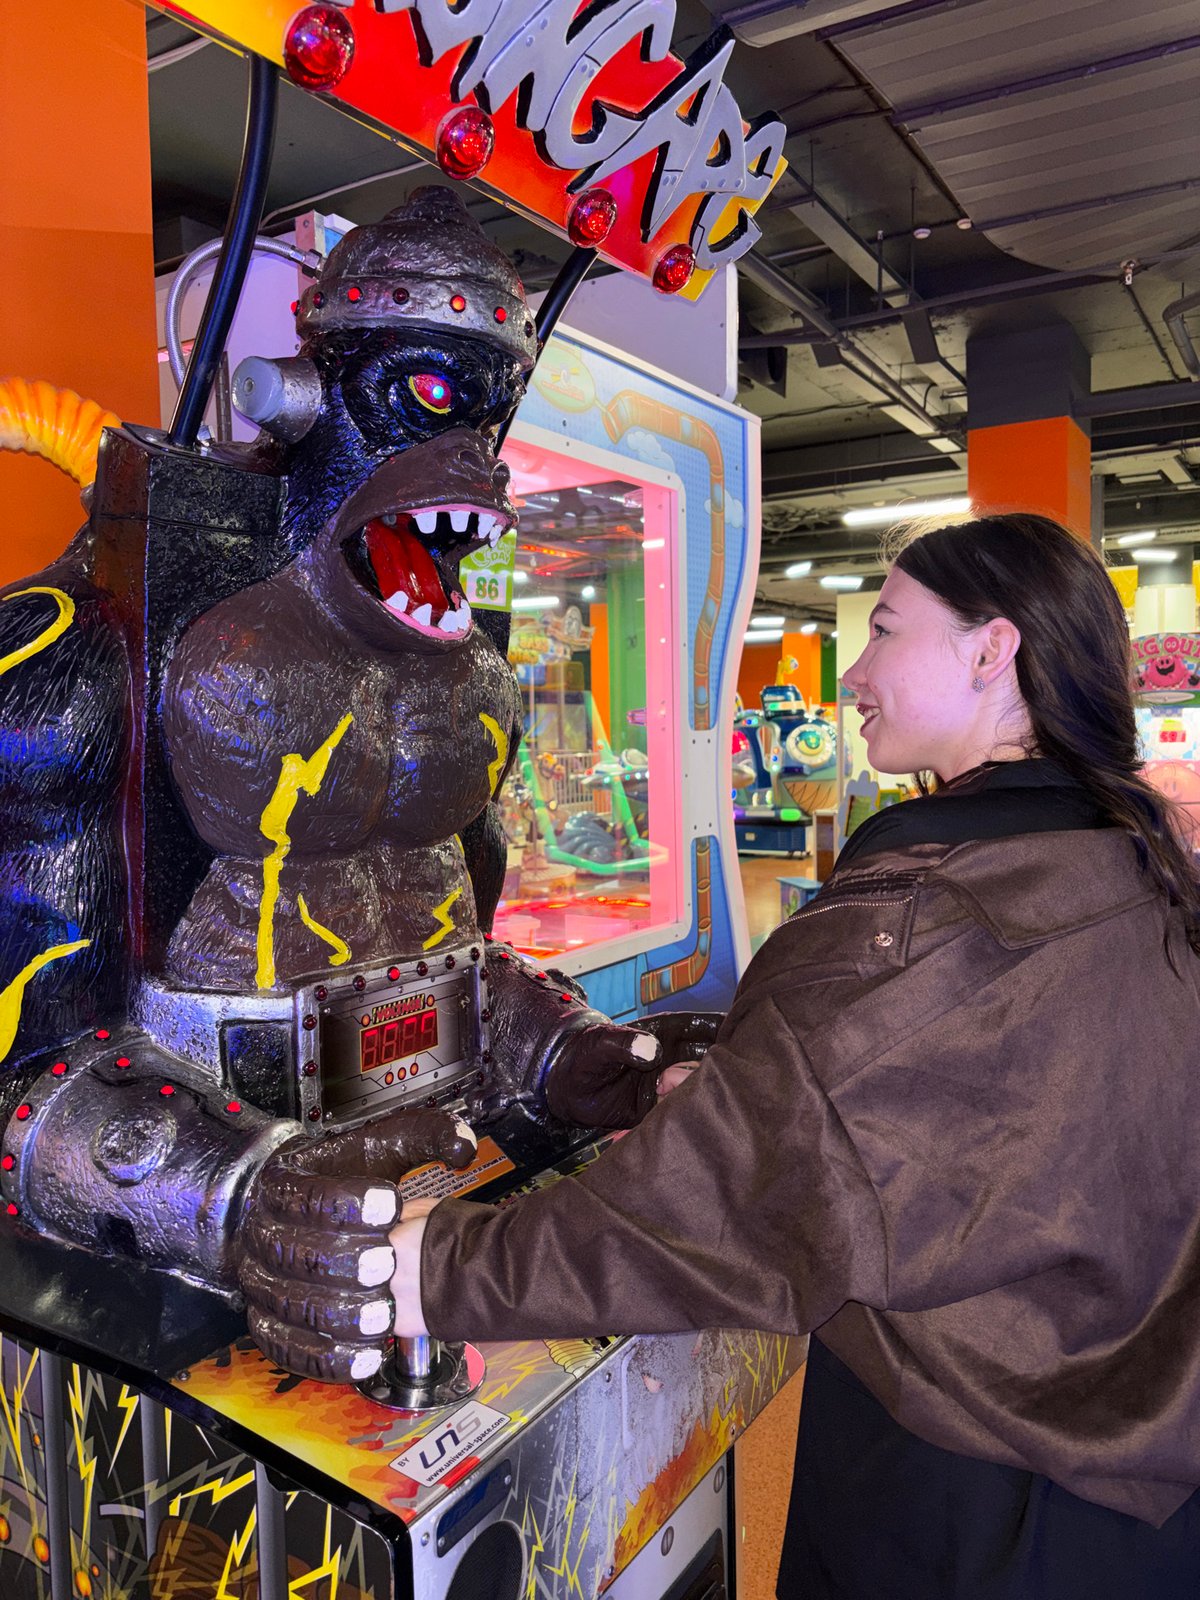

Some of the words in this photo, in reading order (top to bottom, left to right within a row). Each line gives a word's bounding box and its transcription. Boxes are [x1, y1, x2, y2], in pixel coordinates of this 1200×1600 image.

[475, 576, 499, 600] 86
[1132, 637, 1160, 659] IG
[426, 1417, 506, 1483] www.universal-space.com
[397, 1456, 411, 1468] BY
